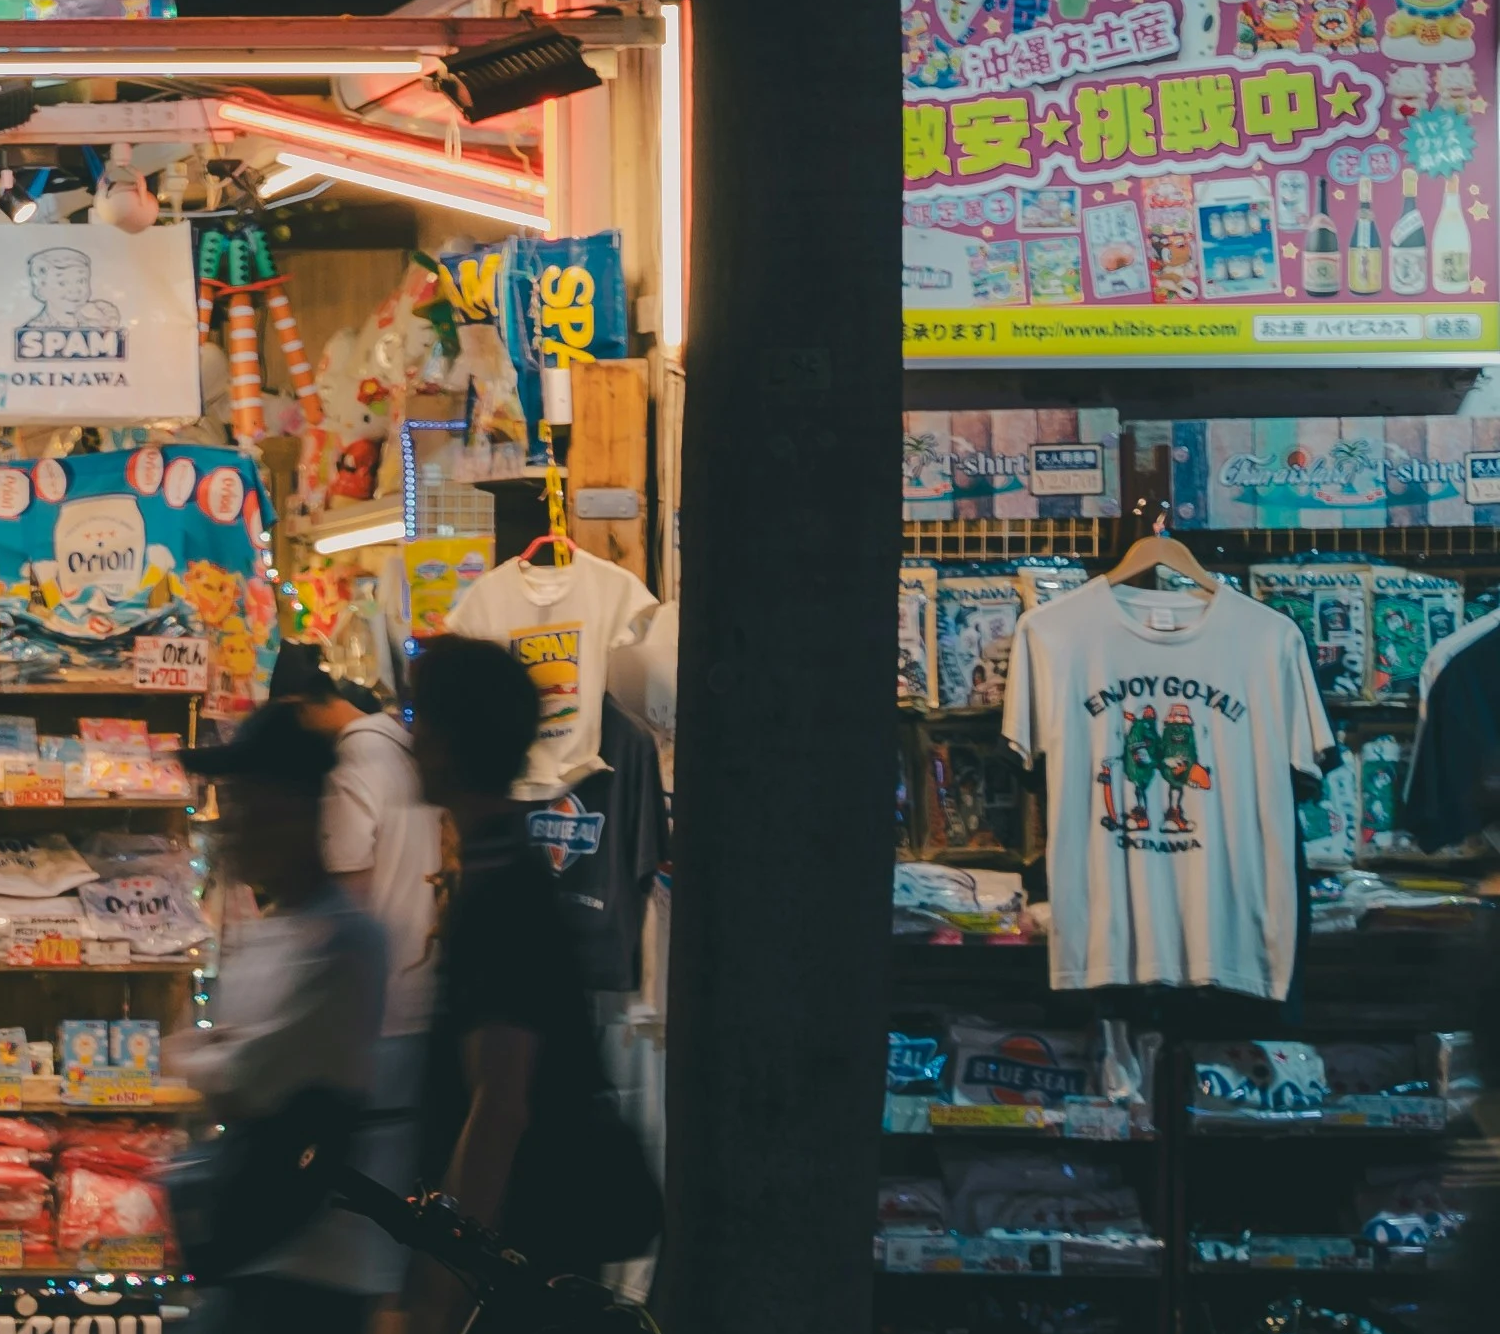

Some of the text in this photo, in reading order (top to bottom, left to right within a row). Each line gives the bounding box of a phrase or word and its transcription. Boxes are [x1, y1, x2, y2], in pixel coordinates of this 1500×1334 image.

[1259, 319, 1307, 339] お土産
[1315, 320, 1408, 338] ハイビスカス
[1433, 318, 1472, 338] 検索
[20, 331, 122, 358] SPAM
[10, 371, 129, 388] OKINAWA
[1083, 675, 1163, 718] ENJOY
[1116, 836, 1203, 854] OKINAWA
